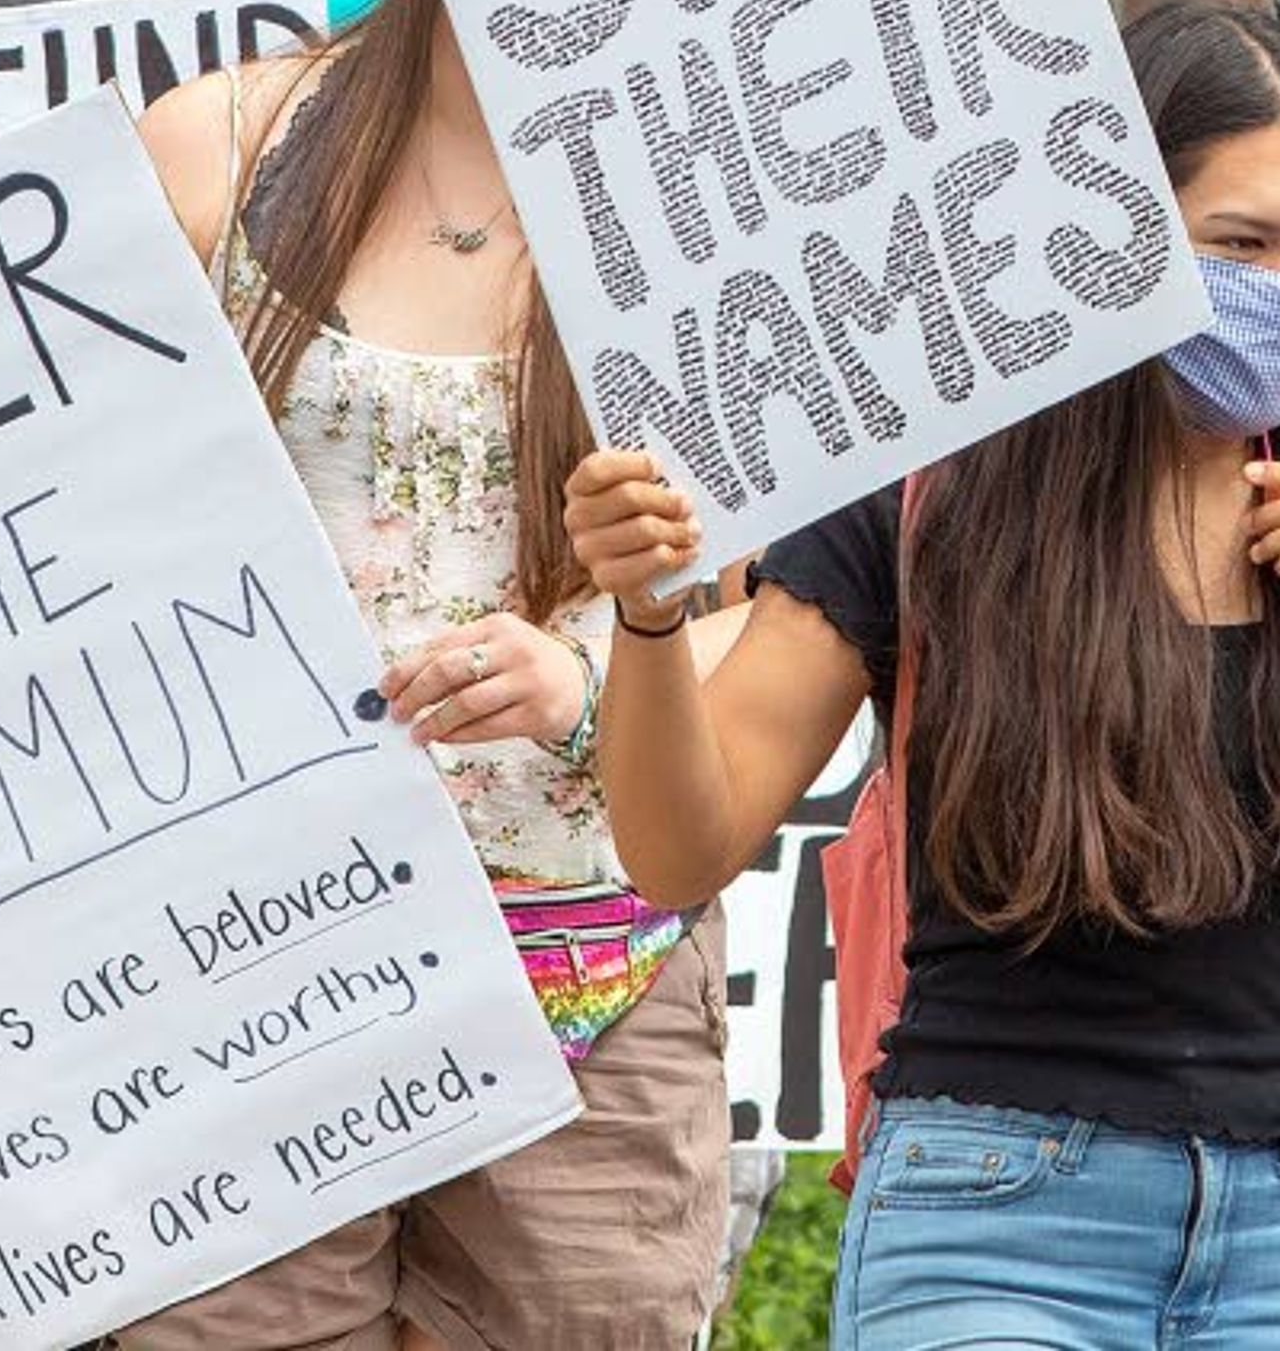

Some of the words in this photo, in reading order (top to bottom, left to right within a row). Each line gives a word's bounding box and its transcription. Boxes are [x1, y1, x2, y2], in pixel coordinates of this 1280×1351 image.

[592, 98, 1171, 511] NAMES
[61, 952, 160, 1024] are
[165, 837, 413, 976] beloved.
[91, 1059, 185, 1134] are
[193, 951, 440, 1071] worthy.
[149, 1169, 251, 1247] are
[274, 1049, 497, 1187] needed.
